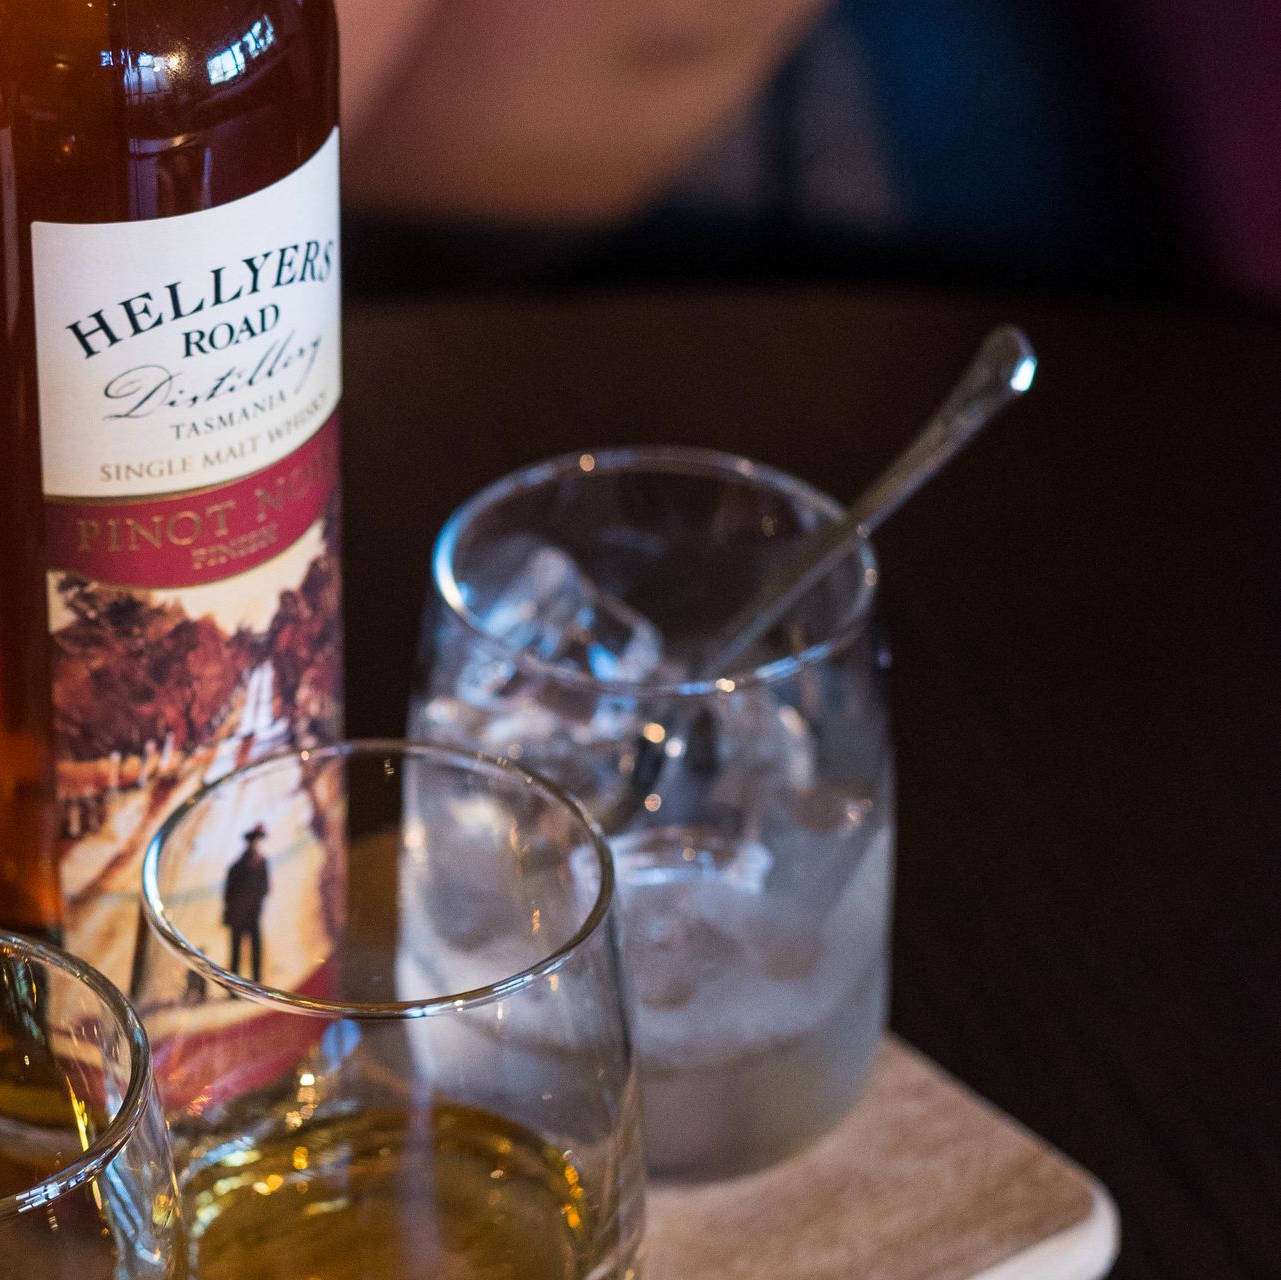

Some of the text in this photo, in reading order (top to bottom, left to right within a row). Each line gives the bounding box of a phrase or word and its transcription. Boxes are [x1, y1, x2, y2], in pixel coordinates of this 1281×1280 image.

[65, 238, 335, 359] HELLYERS
[182, 303, 281, 358] ROAD
[102, 331, 323, 421] Distillery
[170, 391, 287, 441] TASMANIA
[100, 455, 193, 483] SINGLE
[201, 436, 260, 469] MALT
[77, 498, 237, 552] PINOT
